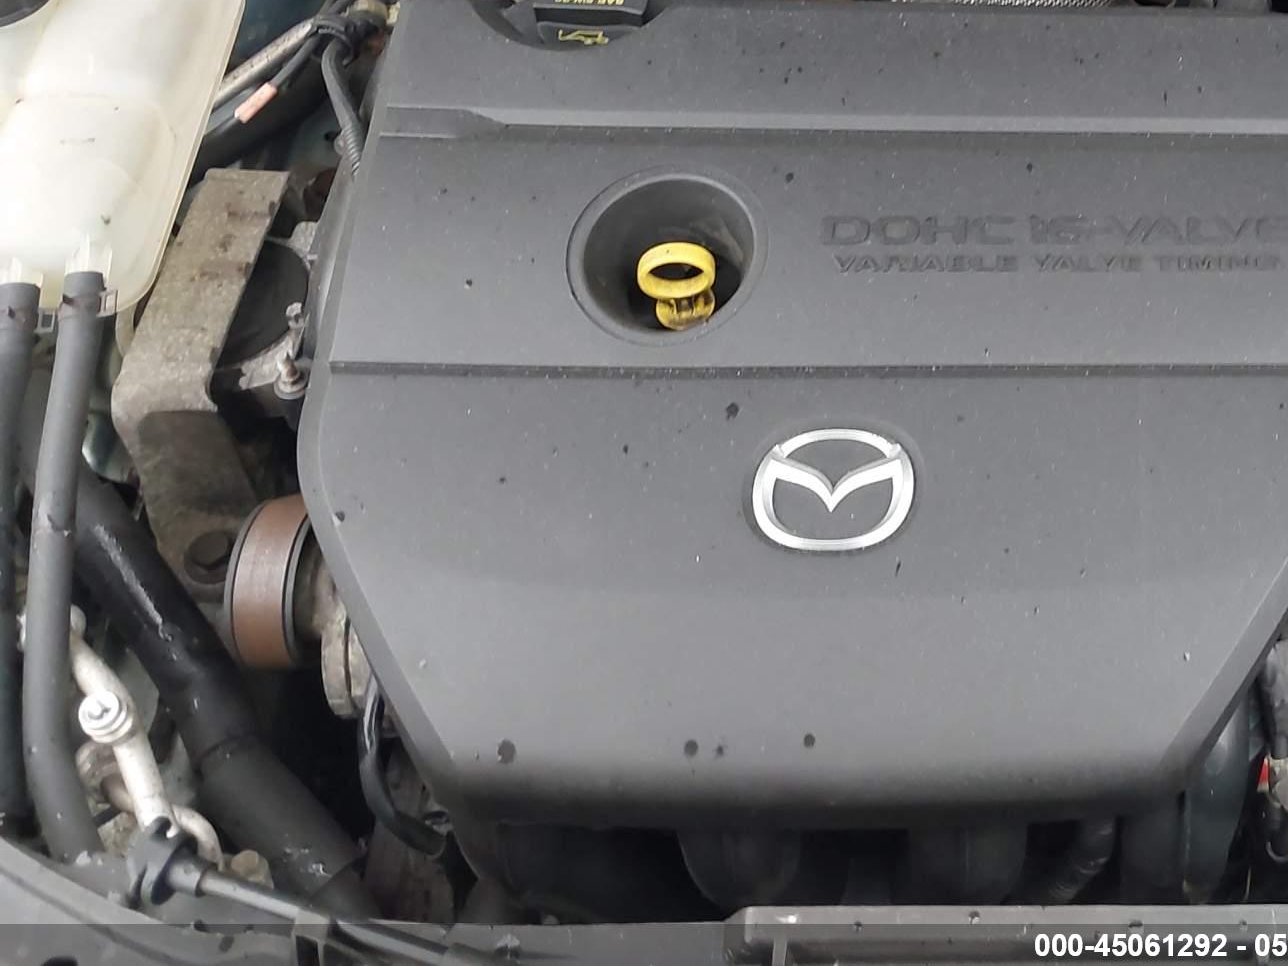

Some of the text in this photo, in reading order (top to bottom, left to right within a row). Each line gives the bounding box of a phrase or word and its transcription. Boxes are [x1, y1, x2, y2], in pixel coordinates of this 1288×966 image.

[821, 215, 1015, 245] DOHC
[832, 253, 1283, 273] VARIABLE VALVE TIMING
